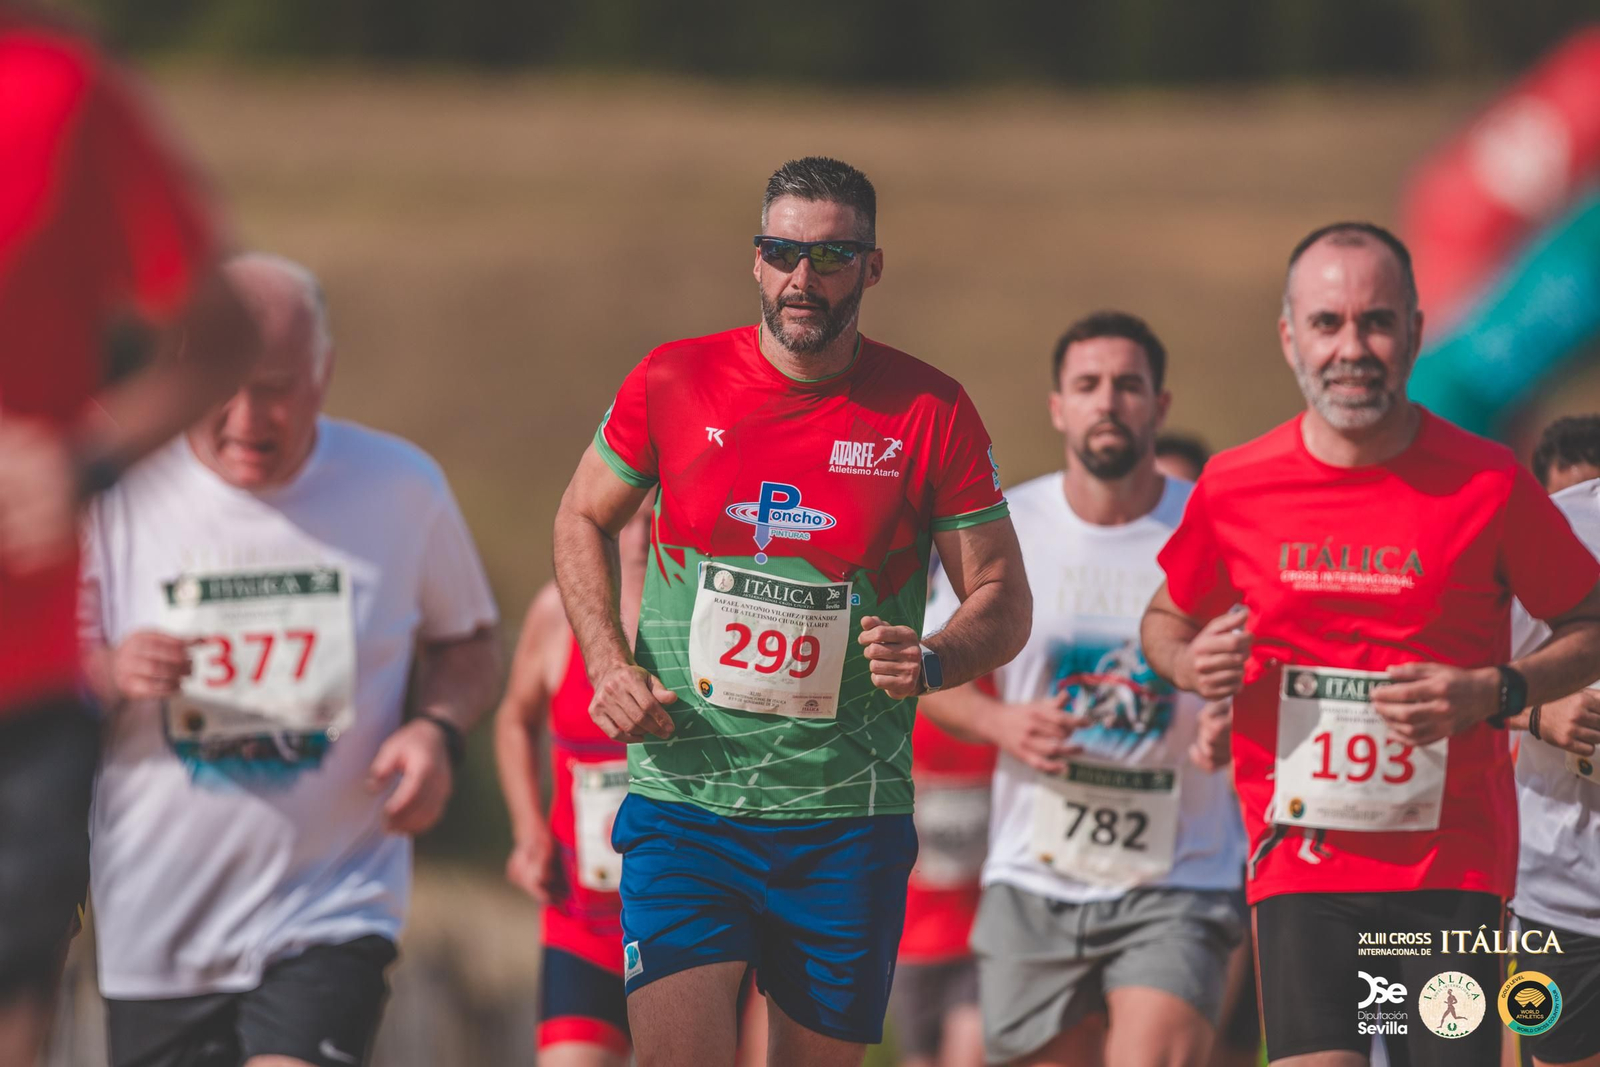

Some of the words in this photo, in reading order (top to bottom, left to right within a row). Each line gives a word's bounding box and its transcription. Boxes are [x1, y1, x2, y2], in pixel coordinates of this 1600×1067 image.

[829, 440, 875, 468] ATARFE
[828, 465, 871, 476] Atletismo
[873, 469, 900, 478] Atarfe
[757, 481, 823, 526] Poncho
[770, 530, 810, 540] PINTURAS
[1279, 536, 1425, 577] ITÁLICA
[714, 597, 739, 608] RAFAEL
[738, 602, 771, 613] ANTONIO
[743, 578, 815, 606] ITÁLICA
[721, 606, 739, 614] CLUB
[740, 610, 777, 622] ATLETISMO
[778, 616, 804, 627] CIUDAD
[204, 627, 316, 689] 377
[719, 622, 821, 679] 299
[1312, 731, 1416, 785] 193
[1065, 801, 1148, 851] 782
